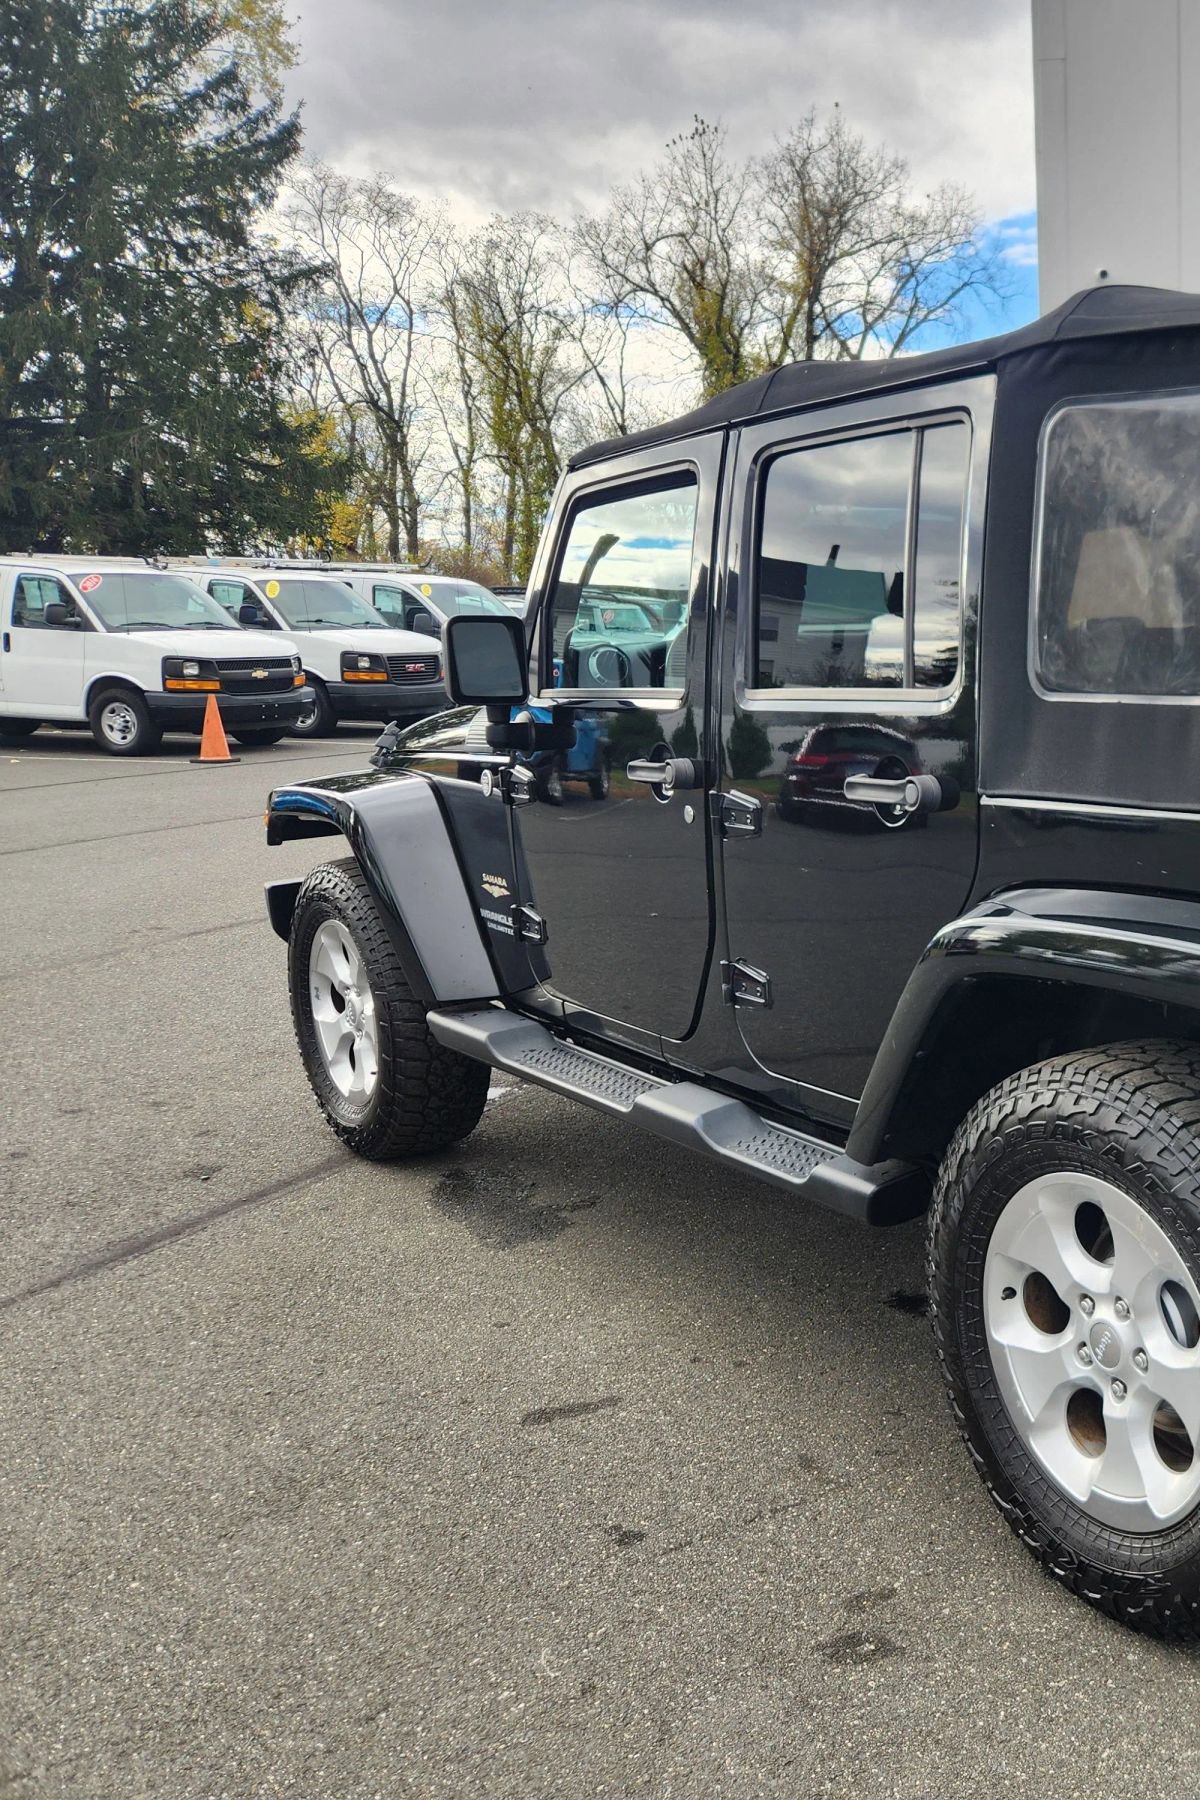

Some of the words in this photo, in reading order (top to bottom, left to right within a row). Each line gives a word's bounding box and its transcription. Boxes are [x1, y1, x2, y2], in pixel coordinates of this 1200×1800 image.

[482, 873, 508, 888] SAHARA
[480, 908, 514, 927] WRANGLE
[487, 921, 515, 936] UNLIMITE
[1100, 1141, 1170, 1195] A/T
